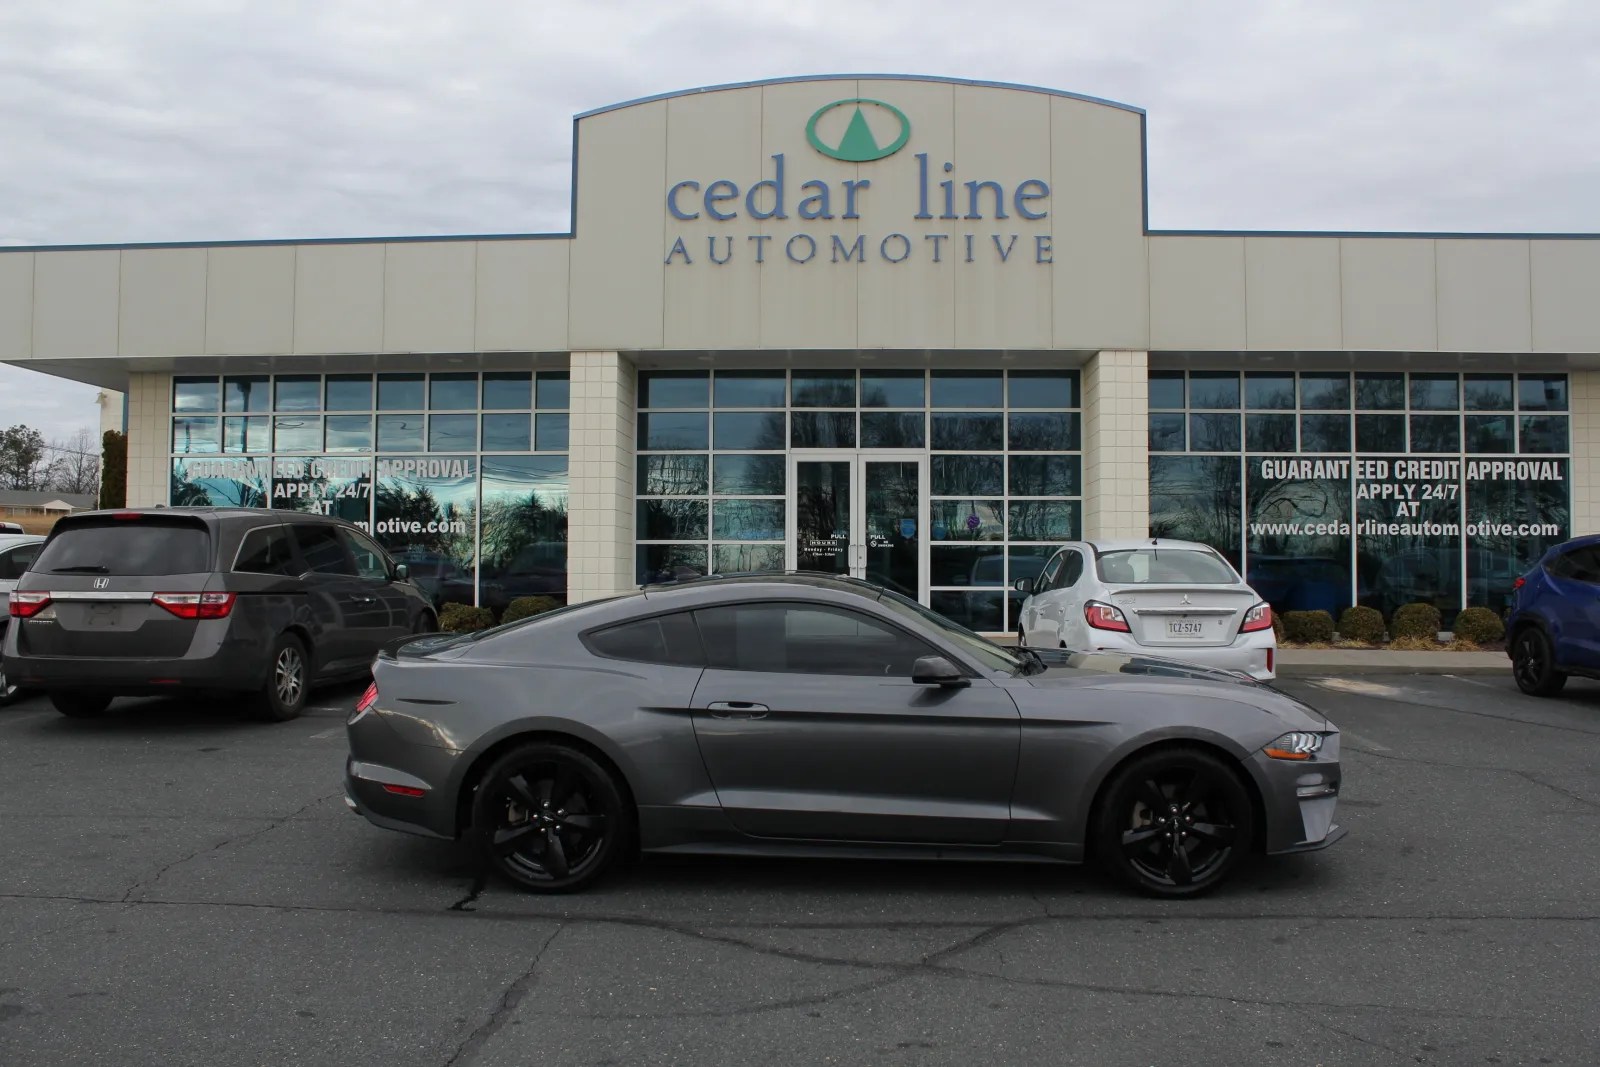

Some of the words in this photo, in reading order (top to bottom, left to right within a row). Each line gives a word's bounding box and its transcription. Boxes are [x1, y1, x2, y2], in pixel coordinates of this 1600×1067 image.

[667, 153, 870, 221] cedar
[914, 153, 1051, 220] line
[664, 233, 1054, 265] AUTOMOTIVE
[310, 460, 372, 479] CREDIT
[379, 459, 473, 478] APPROVAL
[1261, 460, 1388, 480] GUARANTEED
[1394, 460, 1459, 480] CREDIT
[1466, 461, 1563, 481] APPROVAL
[273, 483, 329, 499] APPLY
[335, 483, 371, 499] 24/7
[1356, 484, 1416, 500] APPLY
[1421, 484, 1459, 500] 24/7
[310, 500, 334, 516] AT
[1395, 501, 1420, 517] AT
[1250, 519, 1559, 537] www.cedarlineautomotive.com
[1169, 623, 1202, 633] TCZ-5747
